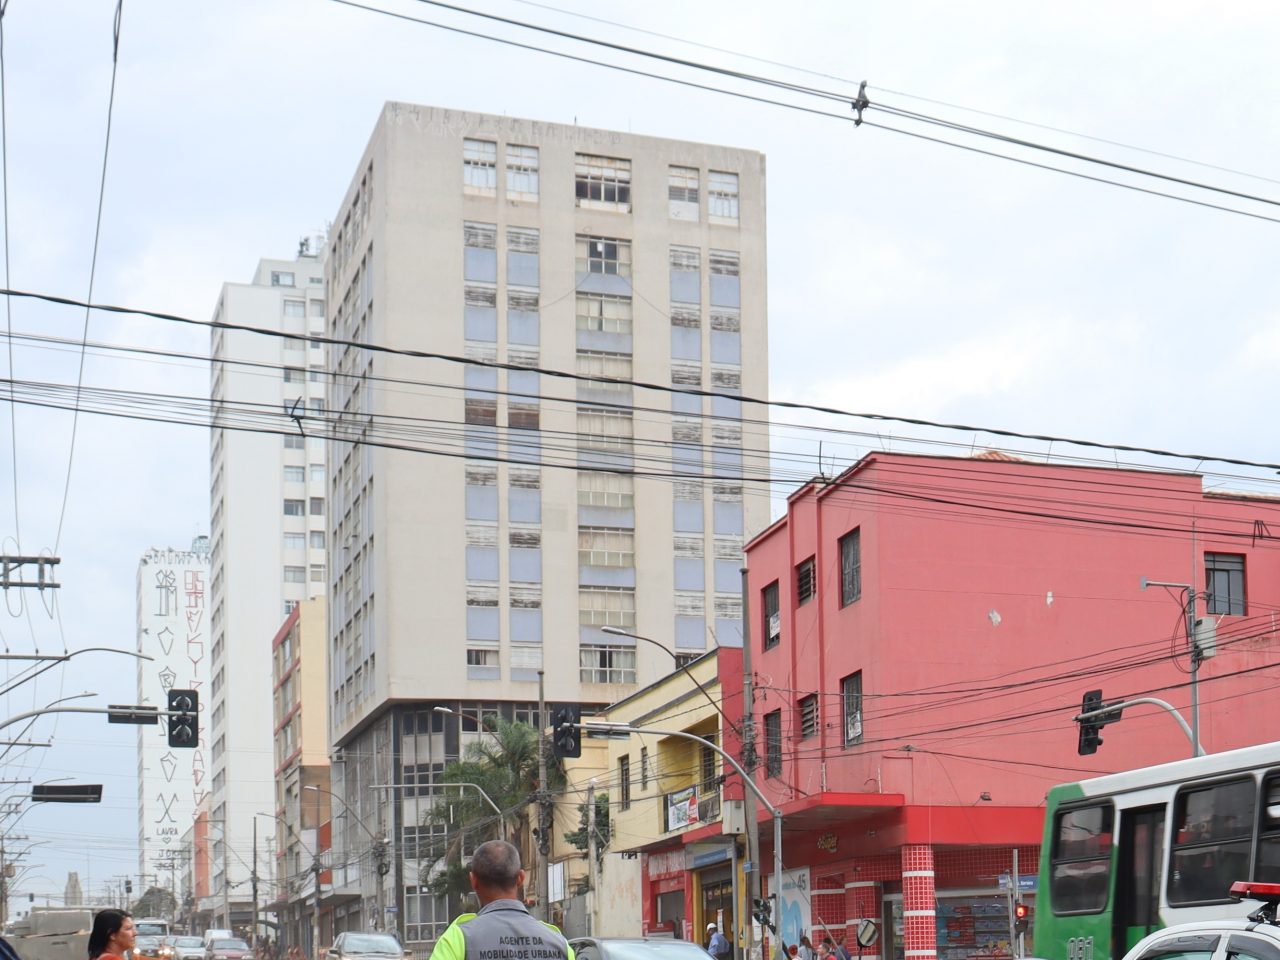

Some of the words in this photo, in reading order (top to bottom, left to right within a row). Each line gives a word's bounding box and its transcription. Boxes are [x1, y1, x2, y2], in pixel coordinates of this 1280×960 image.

[499, 936, 531, 946] AGENTE
[532, 936, 544, 946] DA
[479, 949, 529, 960] MOBILIDADE
[531, 949, 562, 959] URBANA
